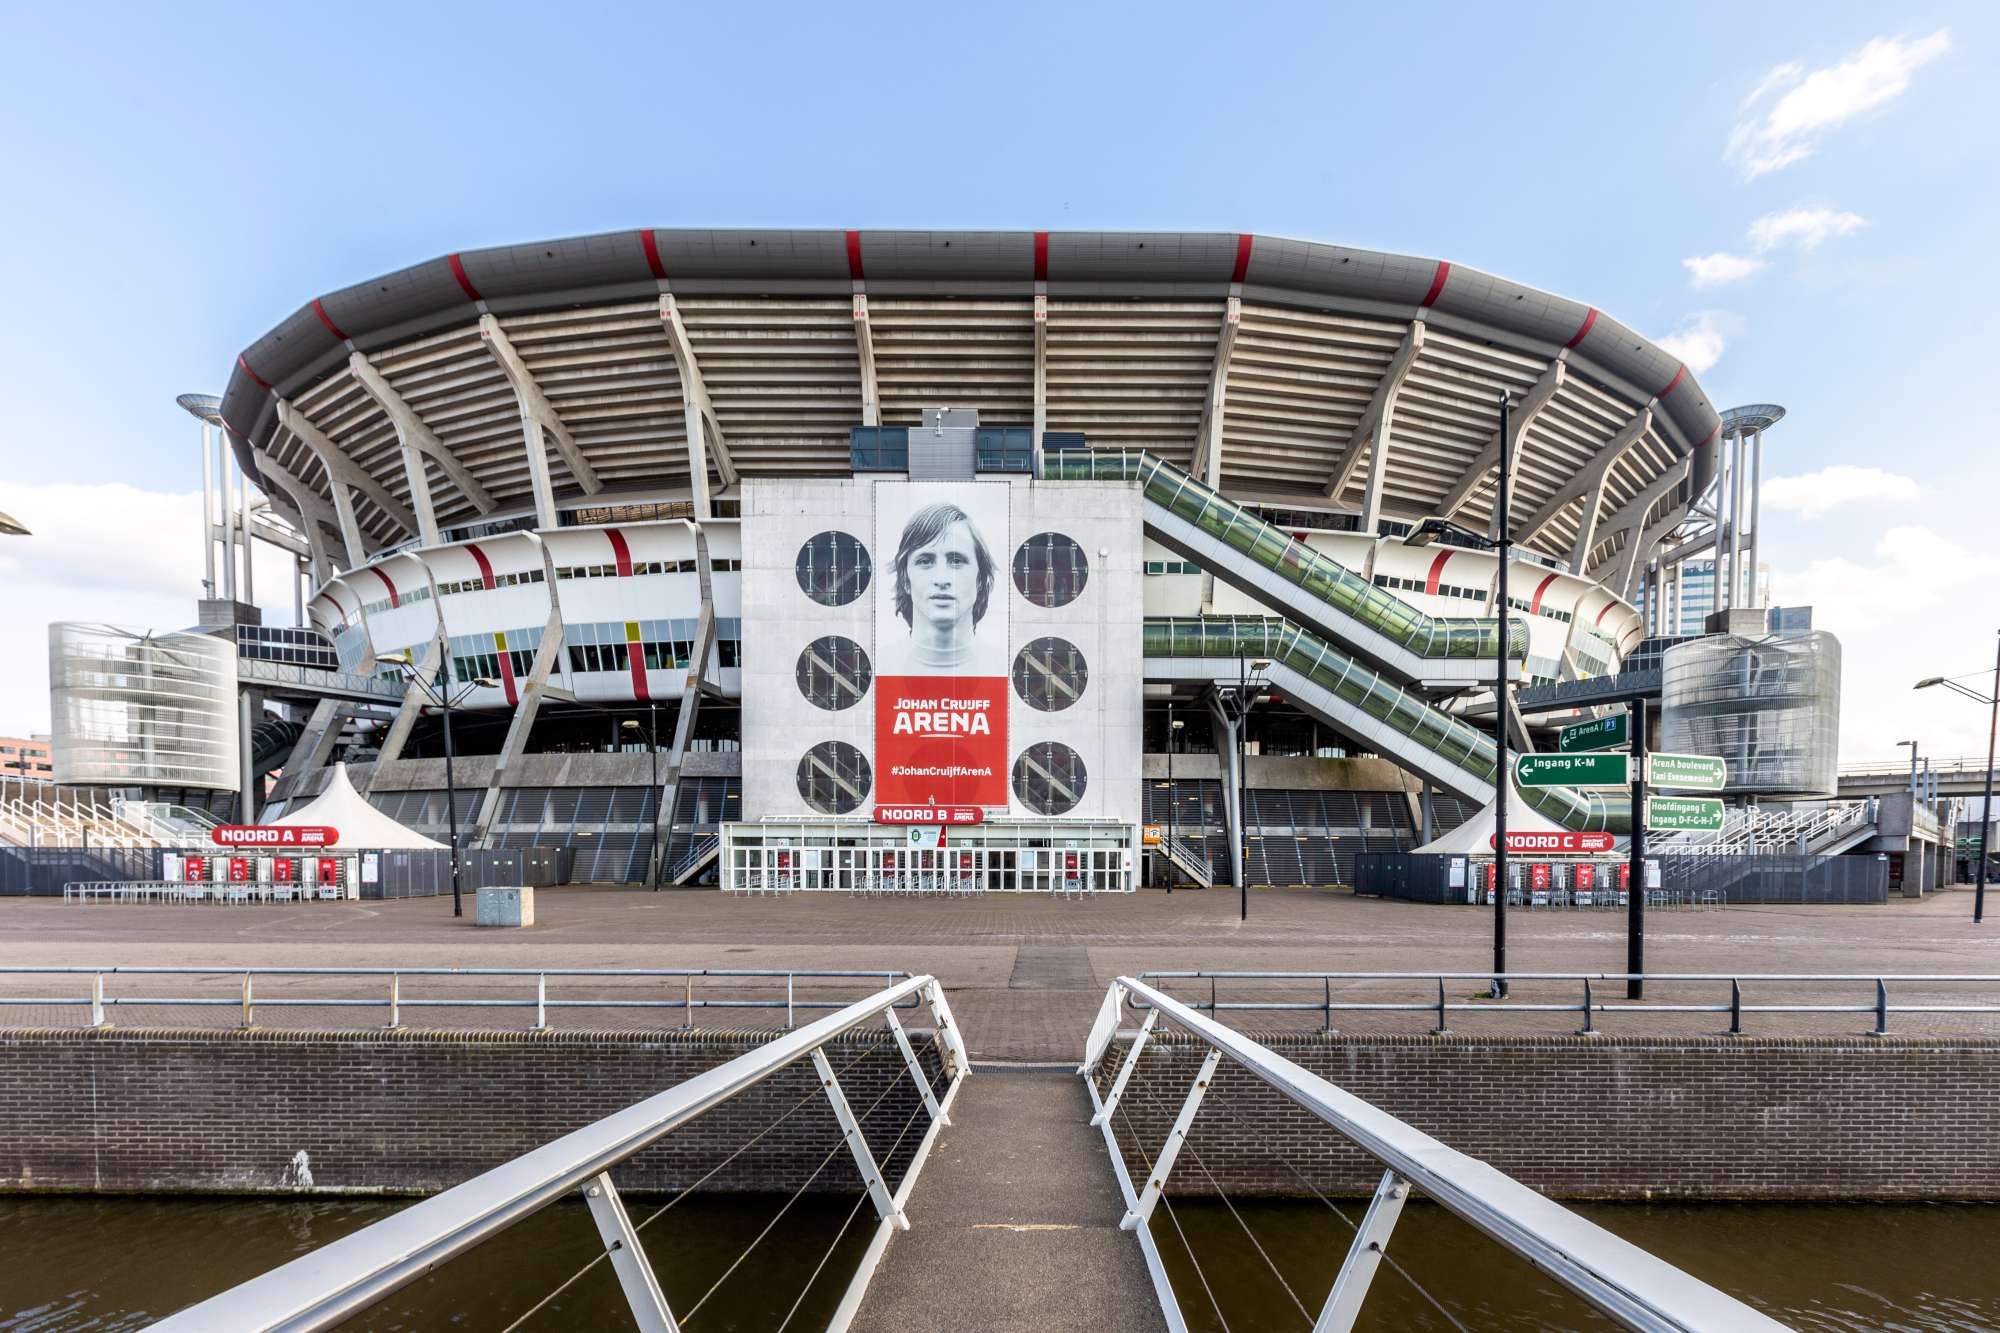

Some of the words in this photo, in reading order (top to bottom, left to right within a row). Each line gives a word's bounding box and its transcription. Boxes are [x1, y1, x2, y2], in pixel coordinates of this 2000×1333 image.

[893, 698, 938, 710] JOHAN
[940, 698, 990, 710] CRUIJFF
[893, 711, 991, 735] ARENA
[1578, 724, 1599, 736] ArenA
[1534, 758, 1571, 770] Ingang
[1574, 758, 1595, 767] K-M
[1652, 758, 1675, 769] ArenA
[1677, 760, 1714, 771] boulevard
[891, 766, 992, 778] #JohanCruijffArenA
[1652, 771, 1666, 780] Taxi
[1651, 801, 1700, 814] Hoofdingang
[1701, 803, 1707, 812] E
[882, 809, 933, 820] NOORD
[937, 809, 948, 820] B
[1651, 815, 1677, 826] Ingang
[221, 830, 279, 842] NOORD
[282, 830, 295, 842] A
[1563, 836, 1573, 848] C
